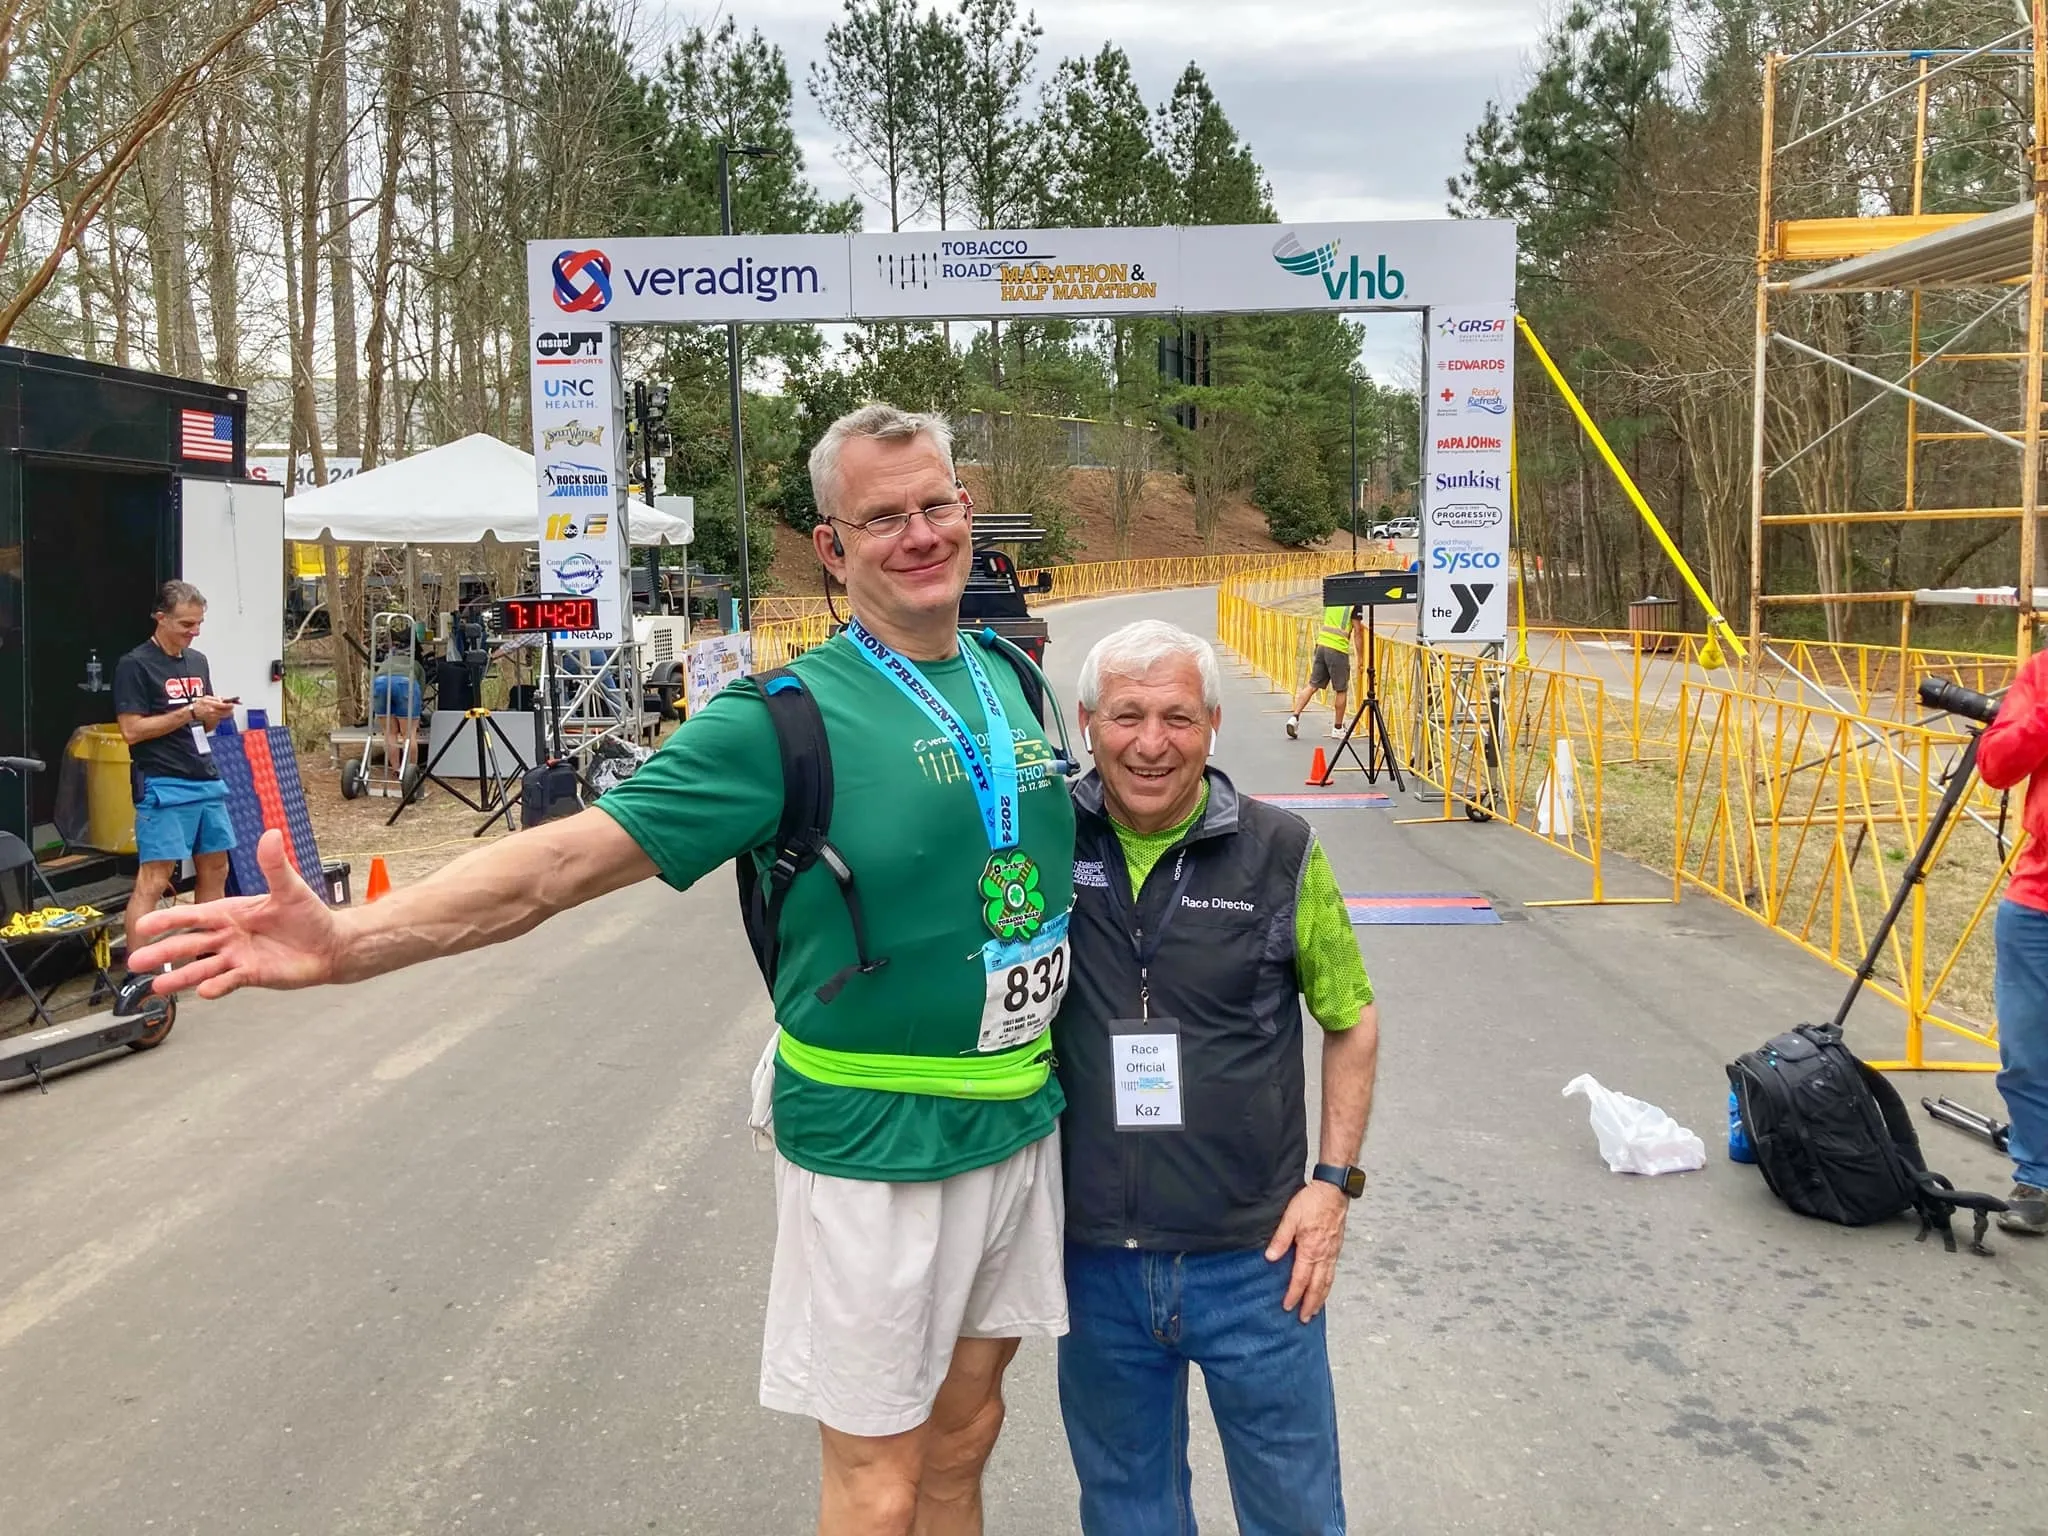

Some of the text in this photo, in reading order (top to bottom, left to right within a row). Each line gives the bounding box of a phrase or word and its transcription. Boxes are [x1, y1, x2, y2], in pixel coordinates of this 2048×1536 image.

[942, 240, 1028, 256] TOBACCO
[942, 263, 992, 279] ROAD
[1001, 264, 1145, 284] MARATHON &
[1322, 254, 1405, 301] vhb
[624, 257, 818, 302] veradigm
[1001, 282, 1157, 301] HALF MARATHON
[1458, 319, 1506, 332] GRSA
[538, 339, 569, 348] INSIDE
[1448, 360, 1505, 370] EDWARDS
[544, 379, 594, 397] UNC
[545, 400, 594, 409] HEALTH
[1437, 435, 1502, 449] PAPA JOHNS
[556, 474, 608, 485] ROCK SOLID
[1436, 469, 1501, 491] Sunkist
[555, 485, 609, 496] WARRIOR
[1432, 547, 1501, 573] Sysco
[510, 602, 592, 628] 7:14:20
[1431, 606, 1453, 618] the
[571, 630, 613, 640] NetApp
[885, 656, 975, 761] PRESENTED
[971, 761, 990, 791] BY
[1001, 795, 1013, 844] 2024
[1181, 895, 1255, 912] Race Director
[1004, 946, 1064, 1012] 832
[1131, 1044, 1159, 1054] Race
[1126, 1062, 1166, 1072] Official
[1135, 1103, 1160, 1116] Kaz
